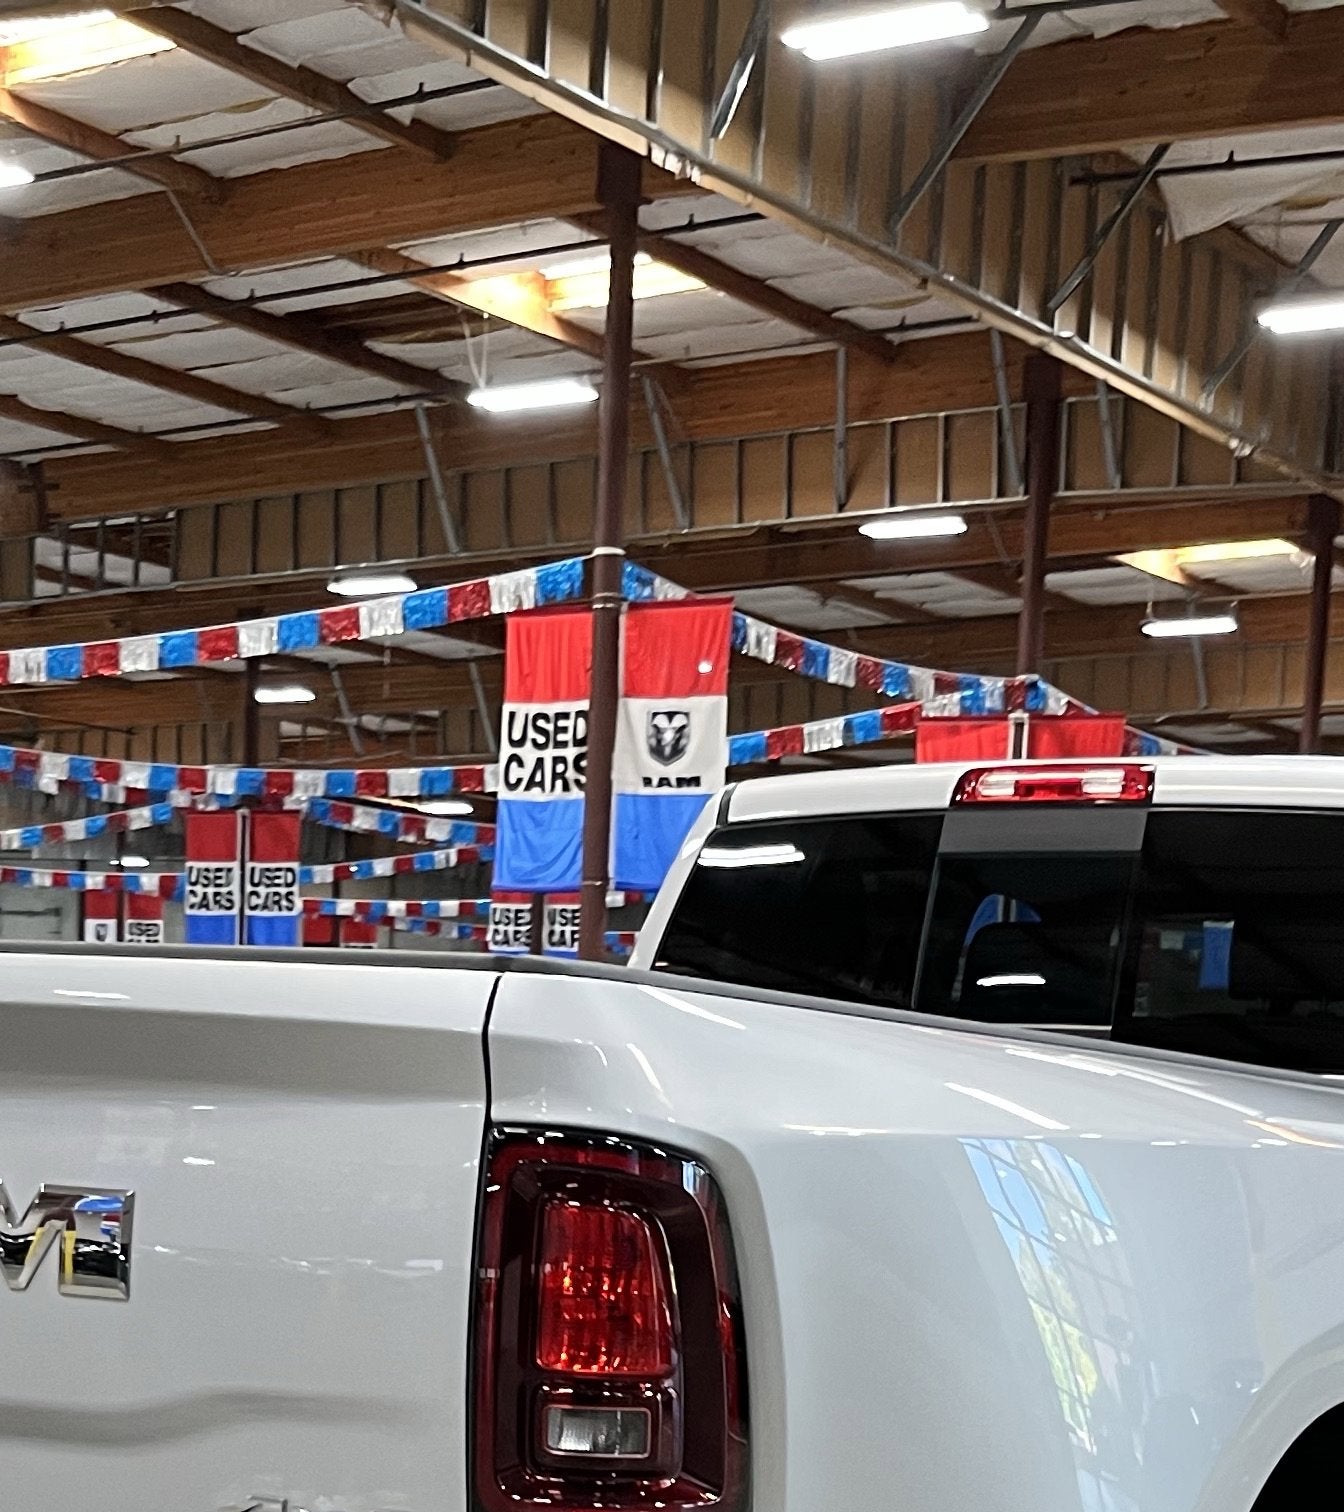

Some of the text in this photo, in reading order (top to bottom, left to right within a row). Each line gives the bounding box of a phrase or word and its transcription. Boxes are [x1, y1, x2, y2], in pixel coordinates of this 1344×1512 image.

[508, 710, 588, 750] USED
[504, 753, 587, 793] CARS
[249, 867, 296, 888] USED
[248, 891, 296, 911] CARS
[548, 908, 580, 926] USE
